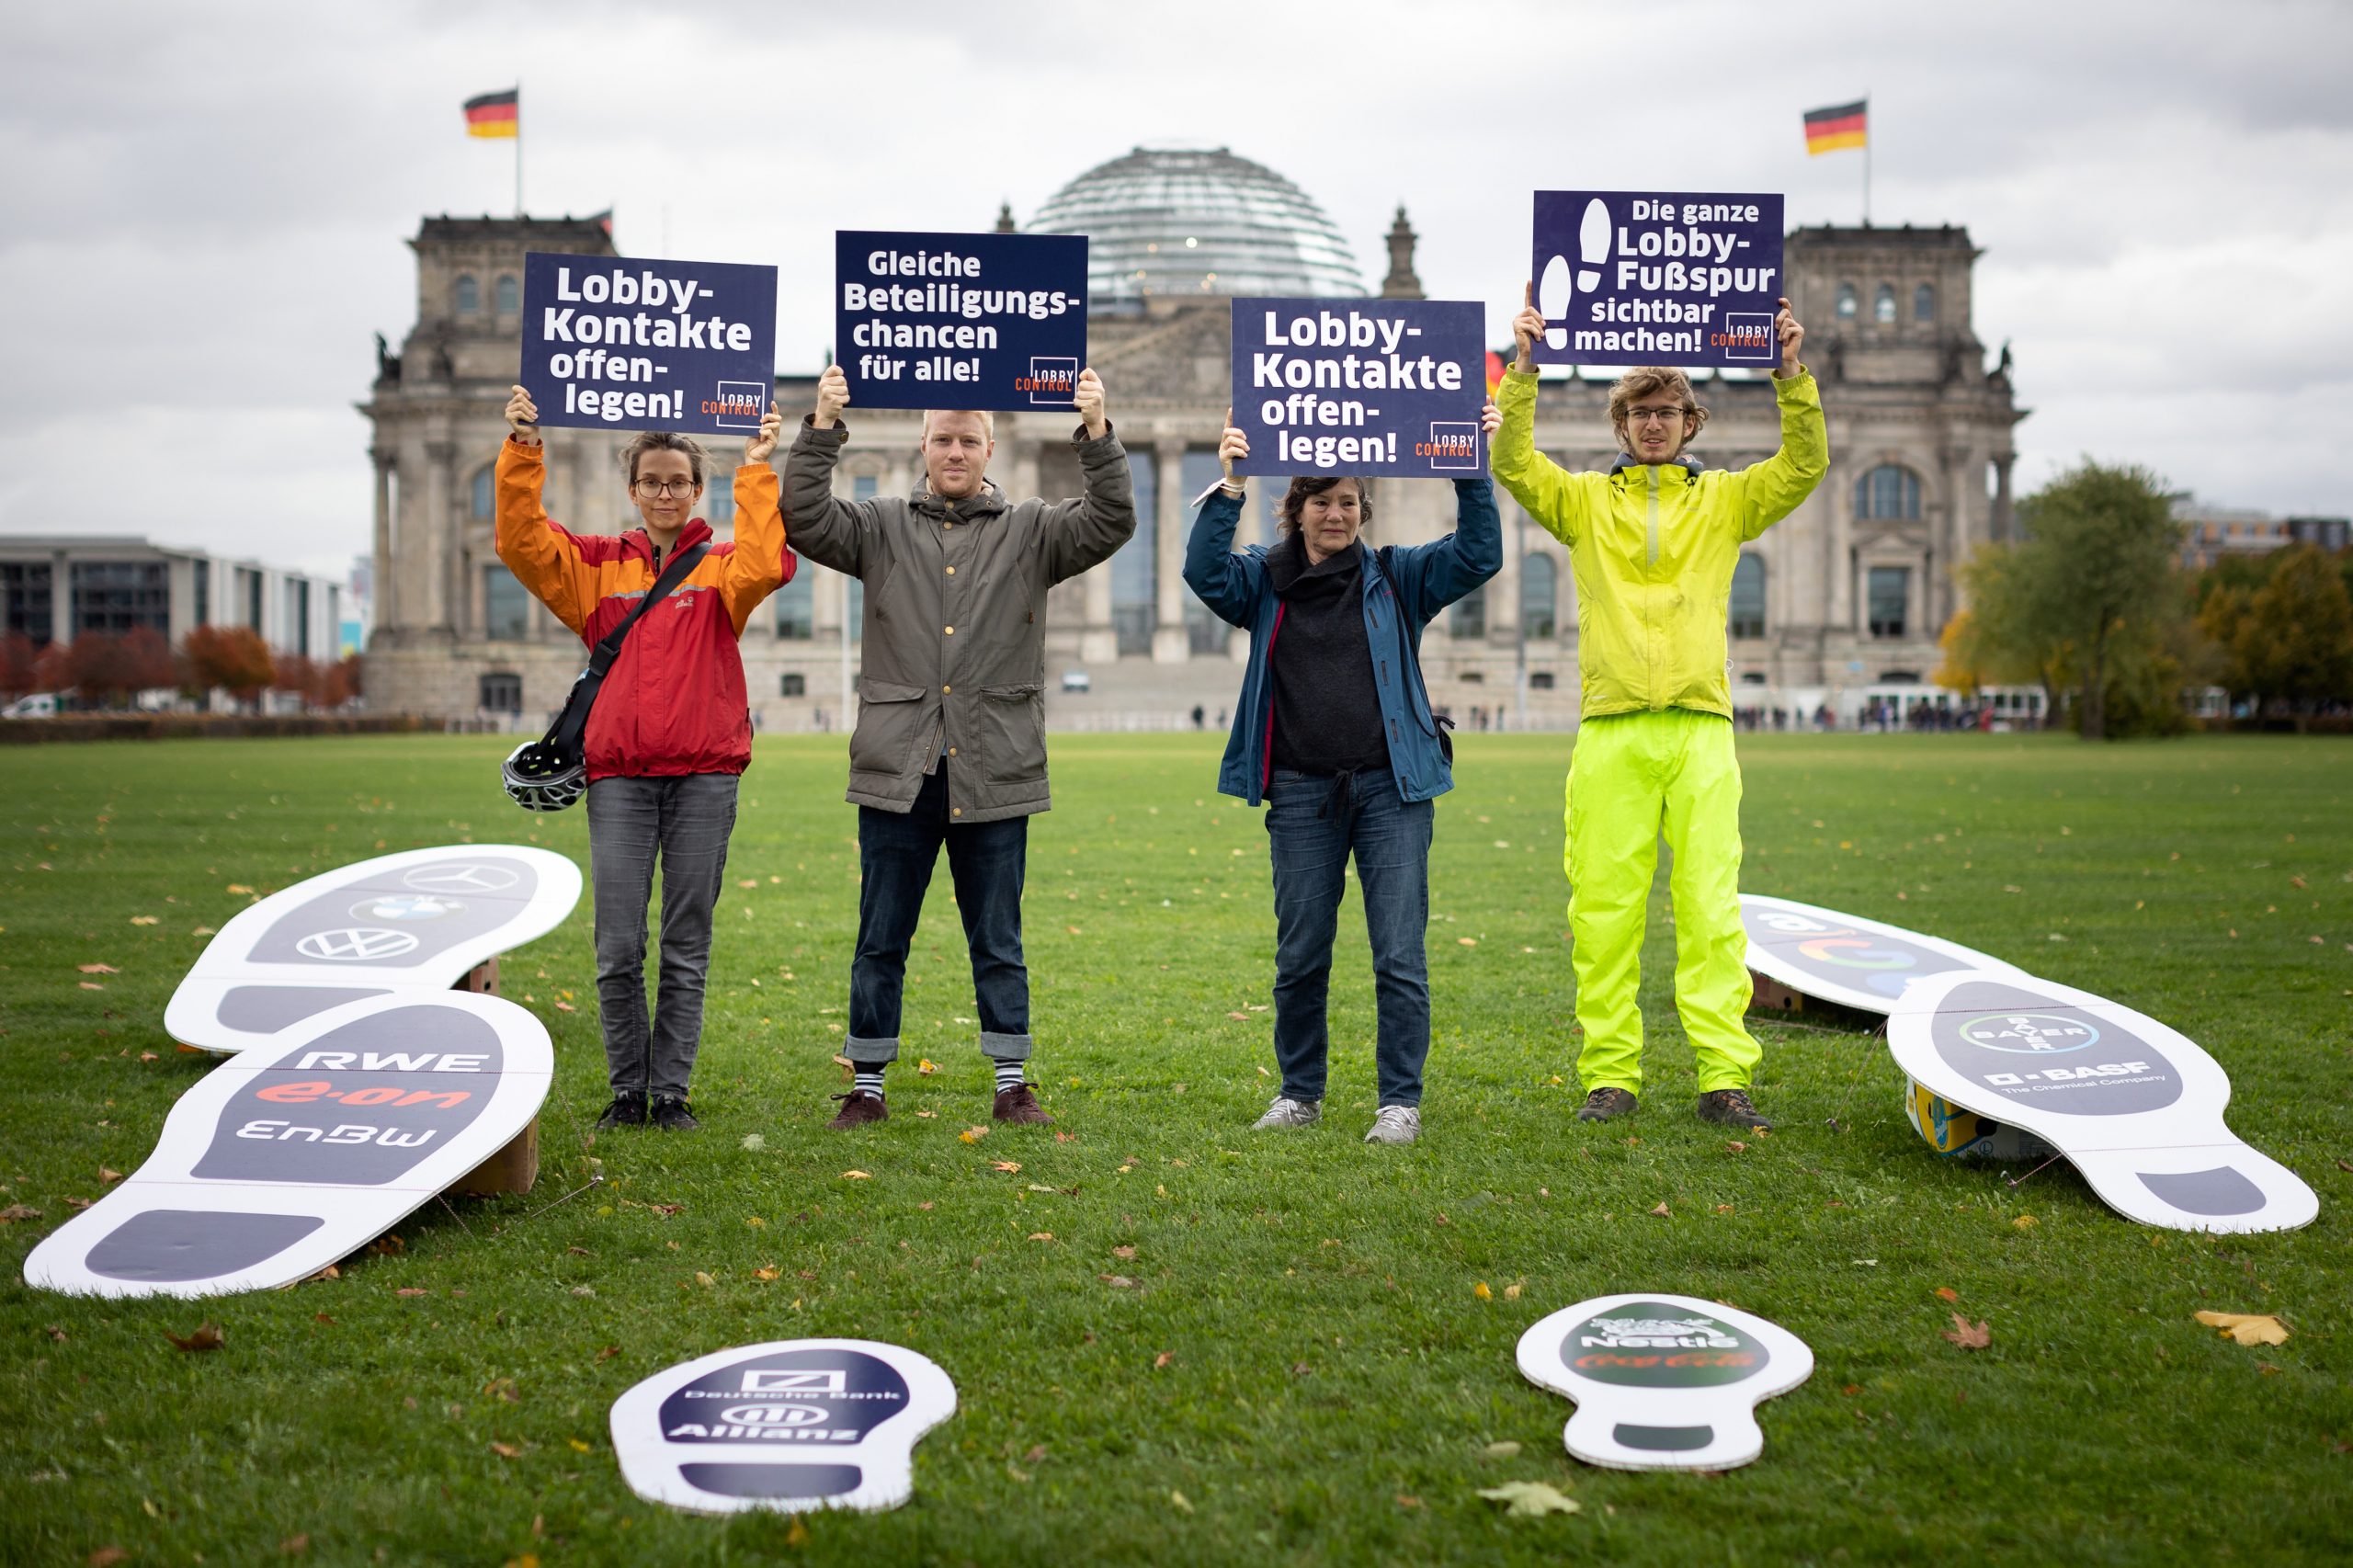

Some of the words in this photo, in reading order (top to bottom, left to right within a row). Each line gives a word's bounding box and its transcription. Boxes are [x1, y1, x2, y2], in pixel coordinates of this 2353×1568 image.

[1632, 199, 1675, 221] Die
[1682, 203, 1759, 225] ganze
[1618, 227, 1750, 264] Lobby-
[868, 250, 981, 277] Gleiche
[557, 267, 713, 314] Lobby-
[1617, 261, 1776, 297] Fußspur
[844, 282, 1080, 320] Beteiligungs-
[1591, 297, 1715, 324] sichtbar
[543, 307, 752, 351] Kontakte
[853, 319, 997, 349] chancen
[1265, 311, 1422, 355] Lobby-
[1574, 327, 1702, 353] machen!
[1711, 333, 1768, 347] CONTROL
[1730, 324, 1770, 339] LOBBY
[550, 348, 668, 382] offen-
[859, 355, 906, 381] für
[915, 357, 980, 382] alle!
[1034, 369, 1074, 383] LOBBY
[1253, 353, 1462, 391] Kontakte
[1015, 378, 1072, 392] CONTROL
[565, 383, 684, 422] legen!
[701, 400, 758, 416] CONTROL
[721, 393, 762, 407] LOBBY
[1261, 393, 1380, 426] offen-
[1279, 430, 1397, 468] legen!
[1415, 442, 1472, 457] CONTROL
[1435, 435, 1474, 449] LOBBY
[294, 1051, 492, 1074] RWE
[2040, 1061, 2151, 1082] BASF
[2001, 1086, 2030, 1095] The
[2032, 1080, 2097, 1092] Chemical
[2099, 1074, 2165, 1086] Company
[235, 1119, 438, 1148] EnBW
[684, 1390, 820, 1400] Deutsche
[829, 1391, 902, 1400] Bank
[667, 1423, 859, 1441] Allianz
